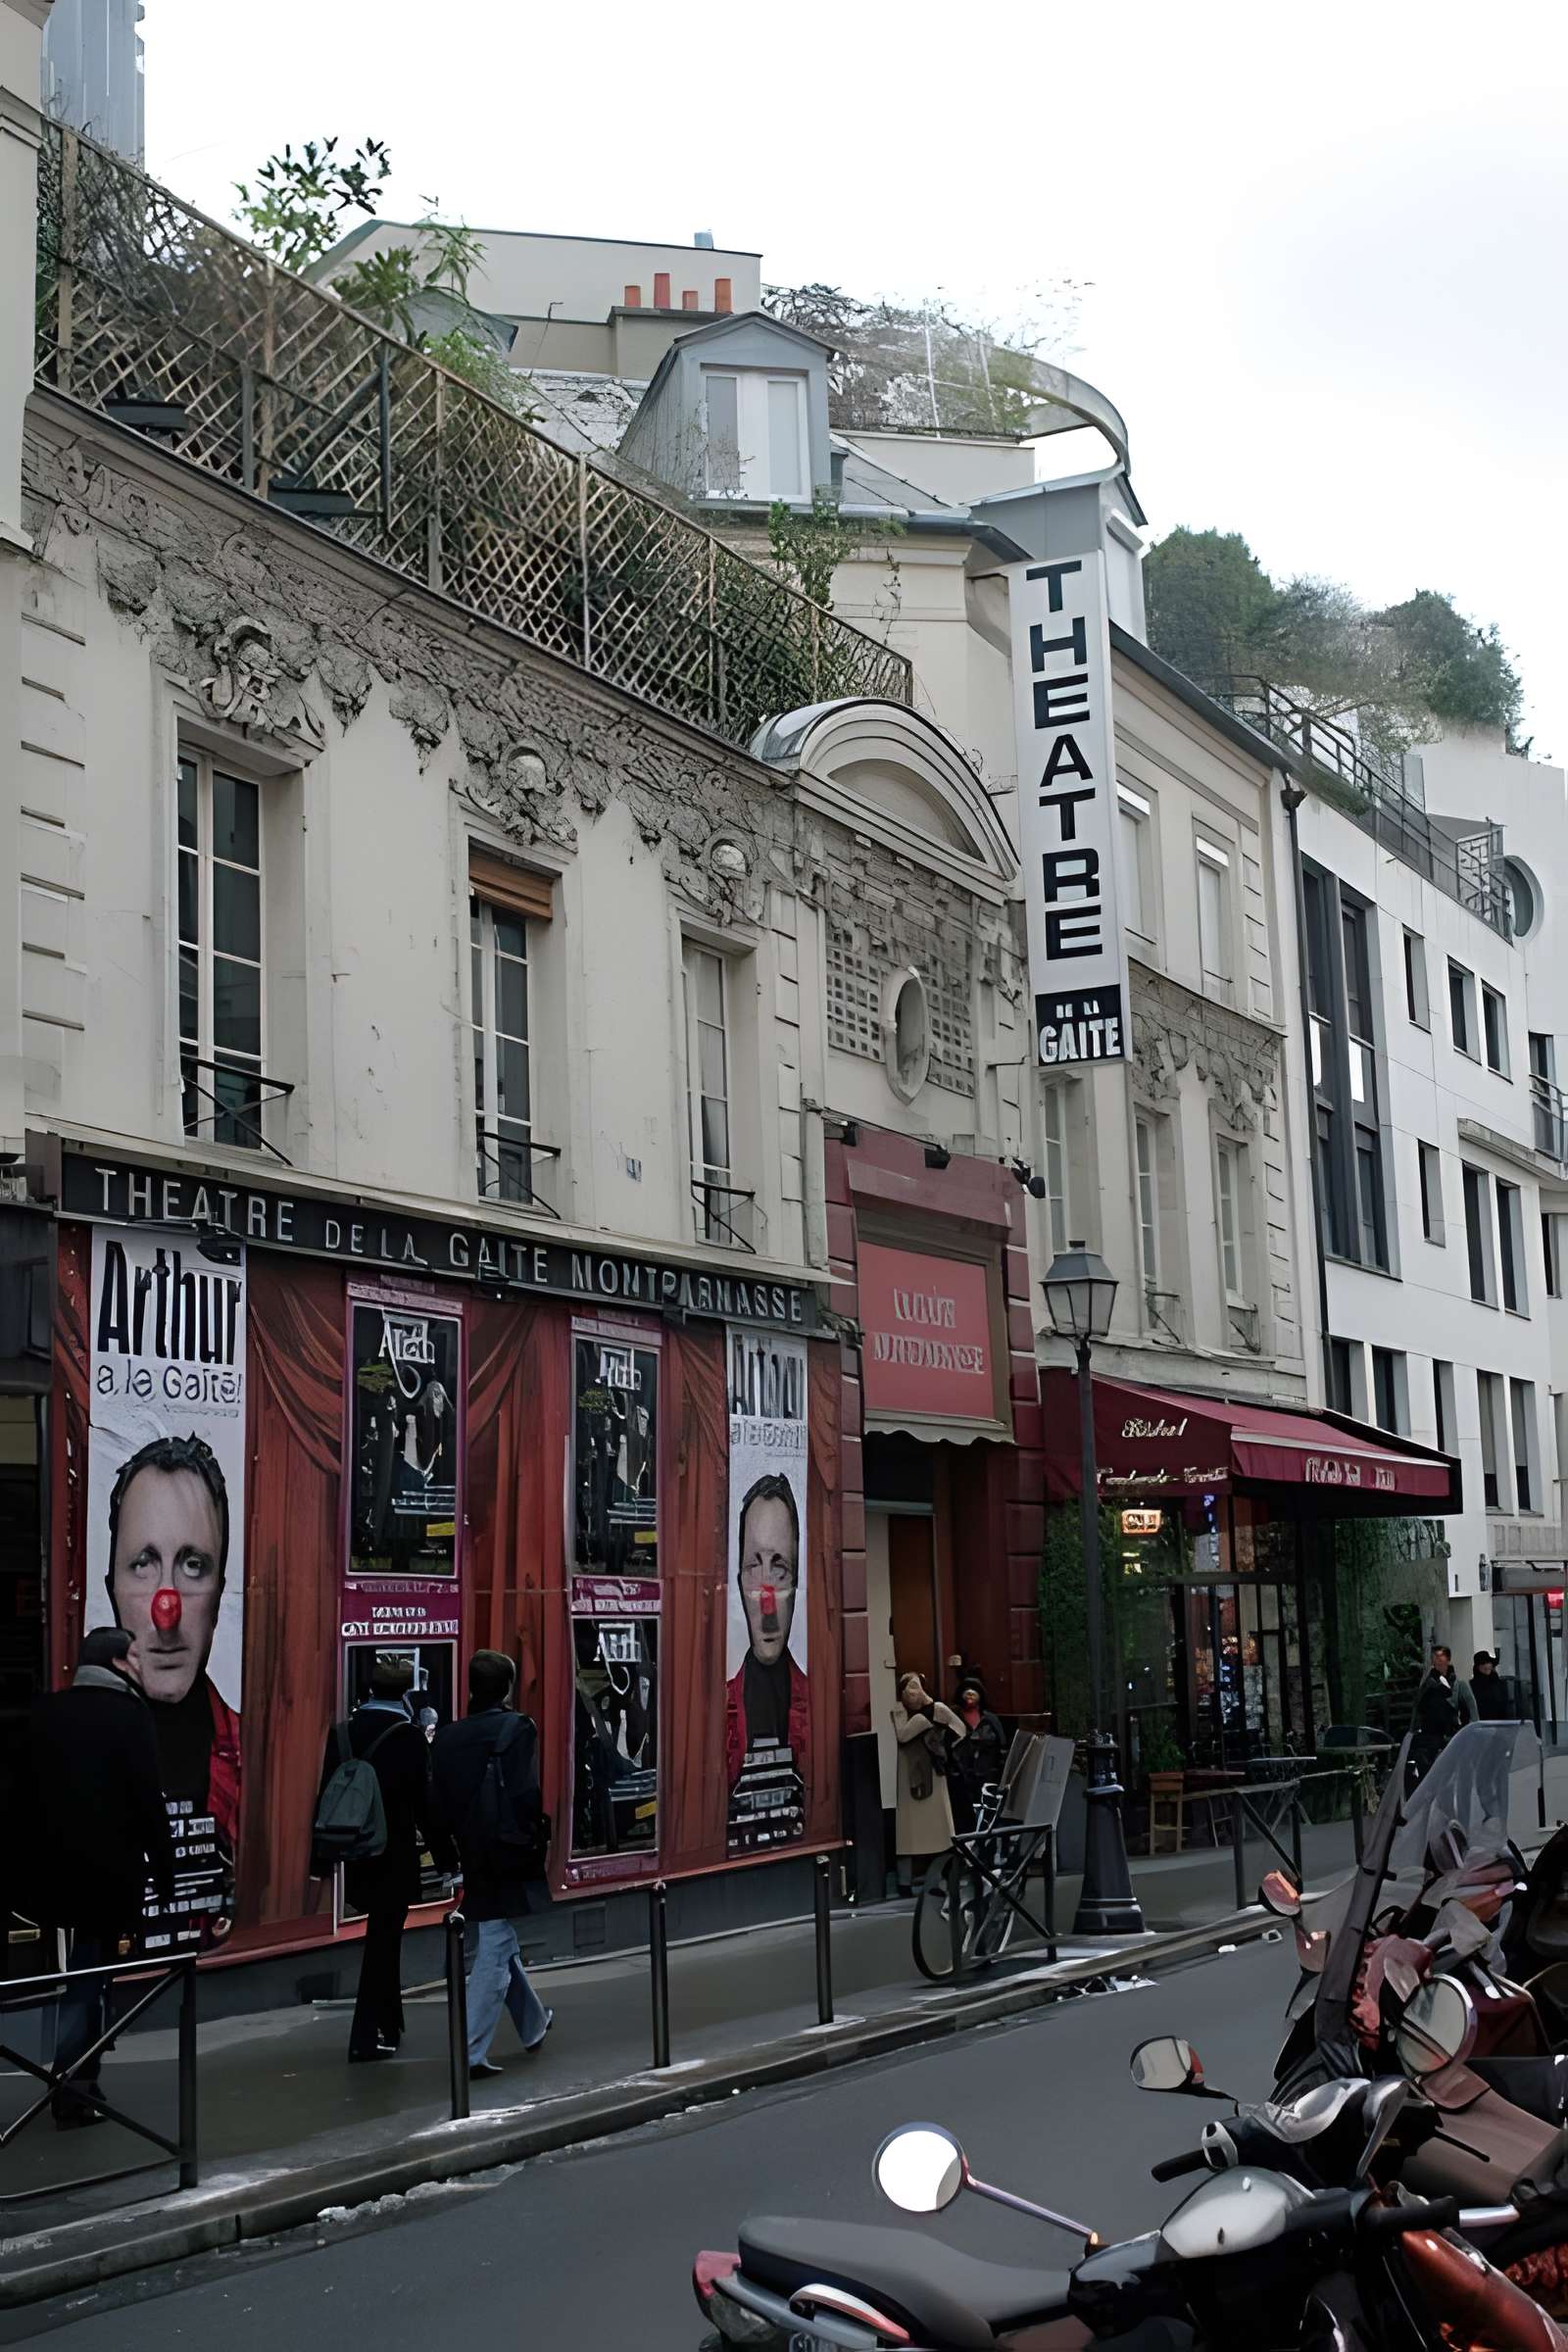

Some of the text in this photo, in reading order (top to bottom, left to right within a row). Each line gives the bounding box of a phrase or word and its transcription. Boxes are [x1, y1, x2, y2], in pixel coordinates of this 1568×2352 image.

[1026, 560, 1102, 960] THEATRE
[95, 1167, 295, 1242] THEATRE
[325, 1219, 364, 1254] DE
[380, 1228, 428, 1266] LA
[98, 1240, 242, 1366] Arthur
